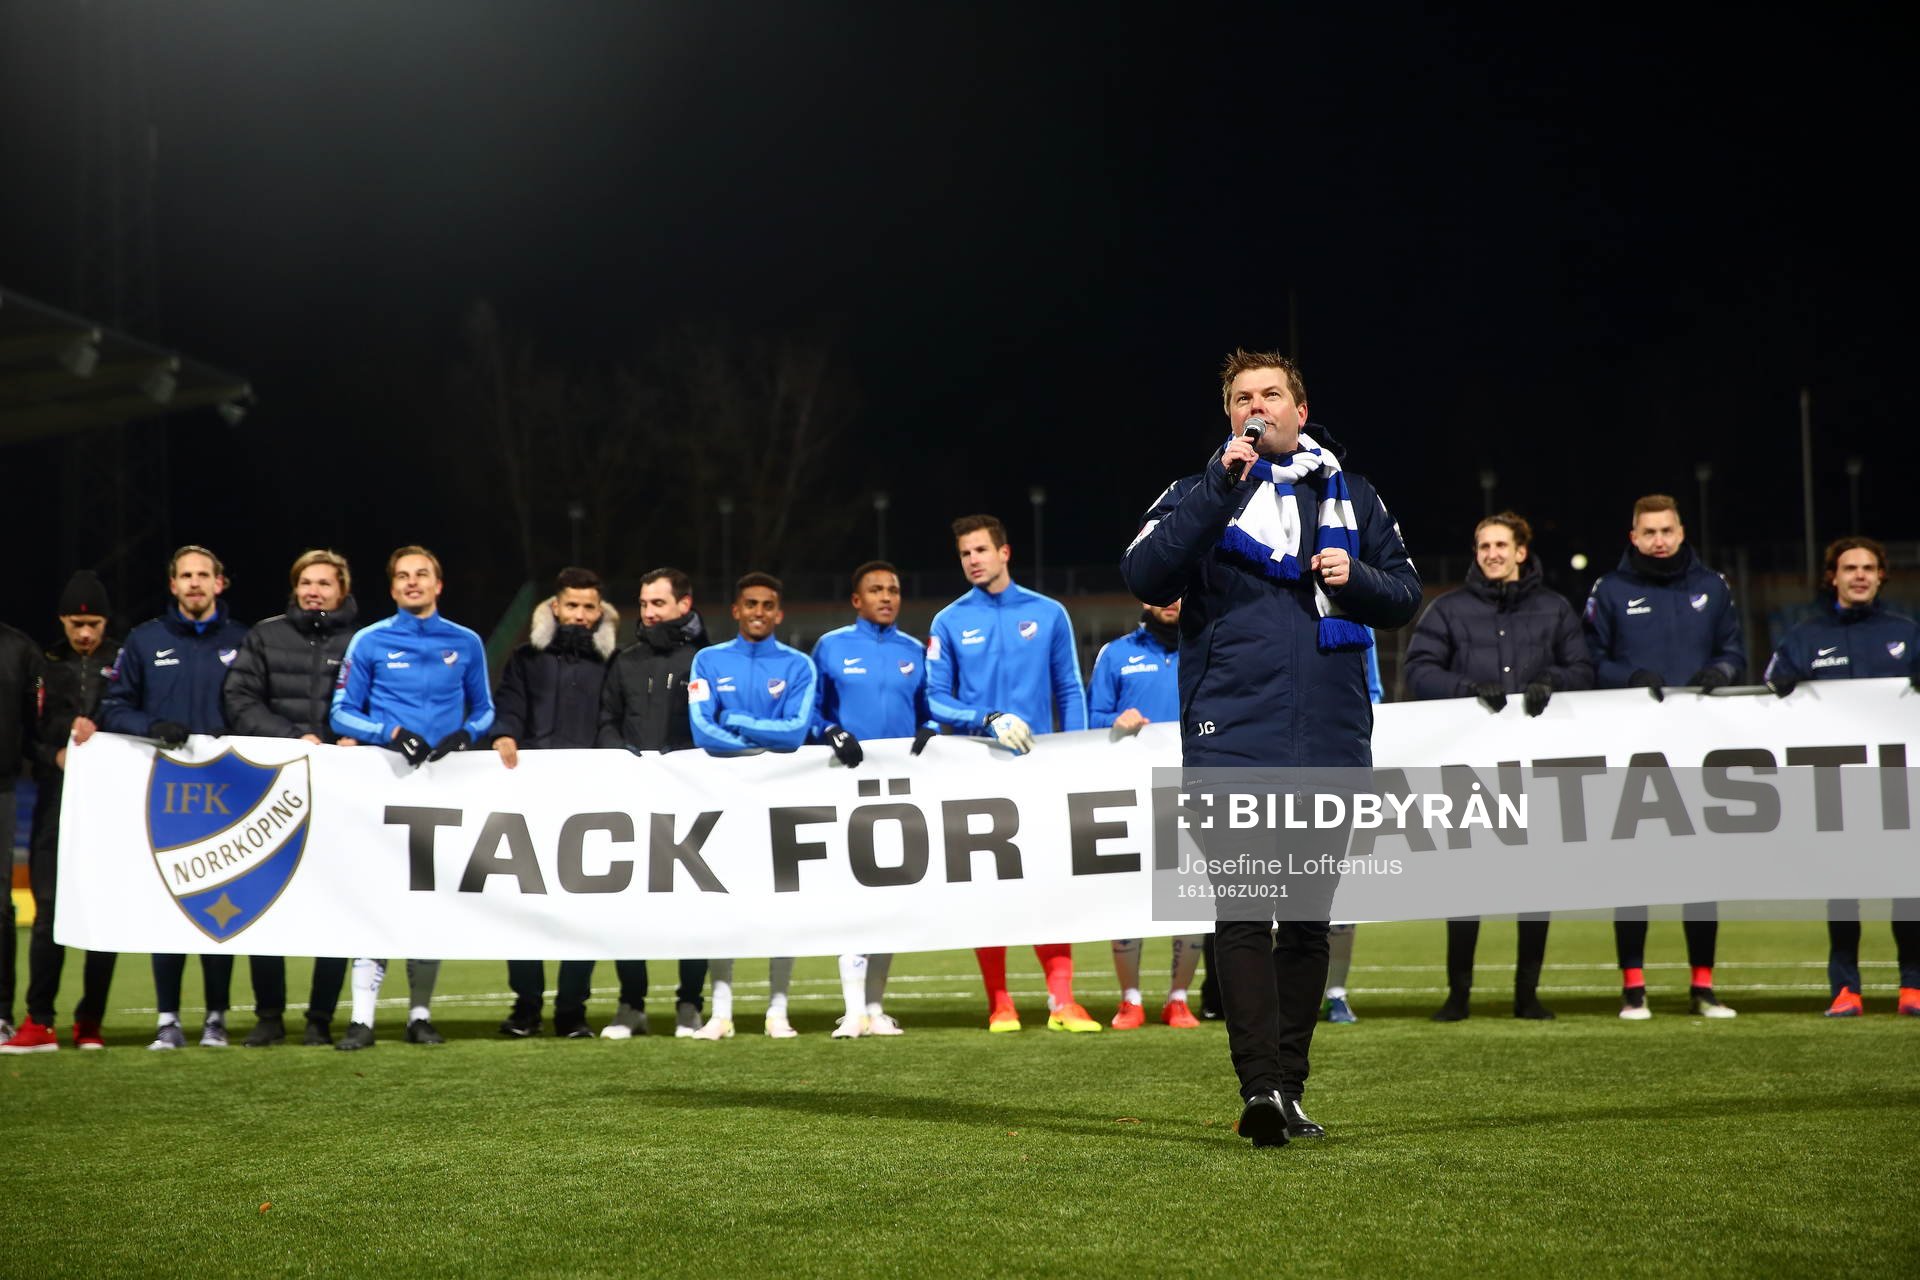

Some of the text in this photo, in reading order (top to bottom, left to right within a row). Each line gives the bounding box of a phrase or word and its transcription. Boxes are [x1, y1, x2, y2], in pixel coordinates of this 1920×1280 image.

[1198, 720, 1216, 737] JG
[162, 781, 231, 815] IFK
[384, 805, 729, 895] TACK
[769, 777, 1024, 893] FÖR
[1347, 743, 1911, 857] ANTASTI
[173, 789, 303, 885] NORRKÖPING
